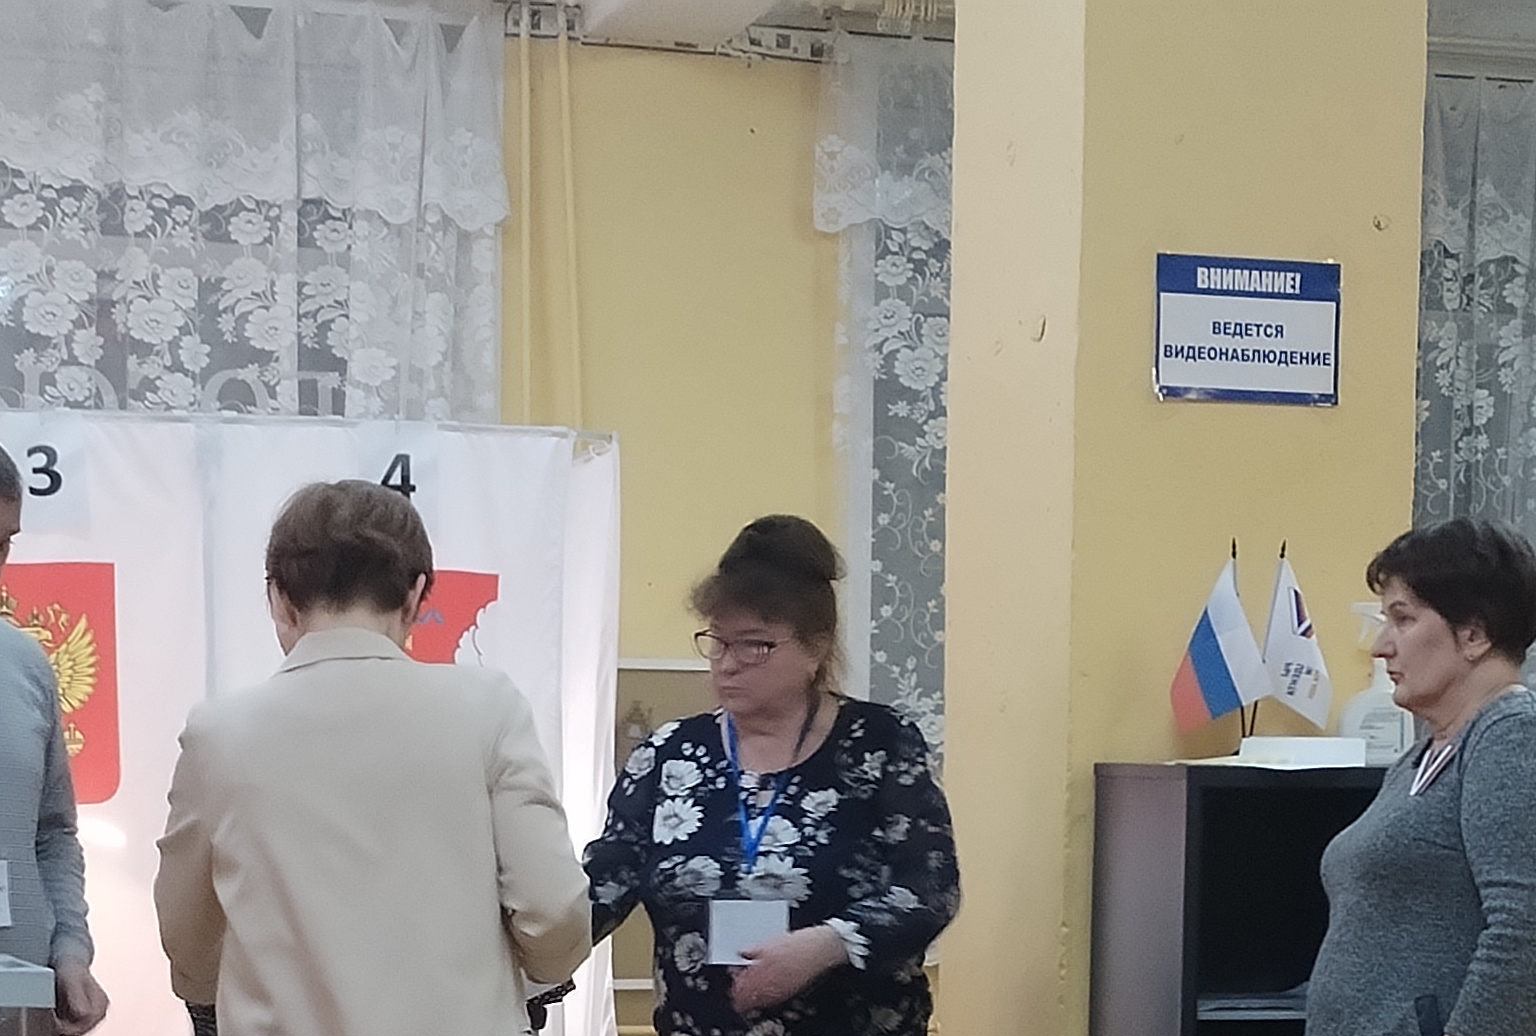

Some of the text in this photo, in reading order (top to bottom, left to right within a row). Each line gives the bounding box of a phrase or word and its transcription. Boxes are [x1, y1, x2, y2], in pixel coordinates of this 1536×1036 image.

[1197, 267, 1302, 294] ВНИМАНИЕ!
[1212, 320, 1285, 340] ВЕДЕТСЯ
[1163, 344, 1332, 367] ВИДЕОНАБЛЮДЕНИЕ
[26, 444, 63, 497] 3
[380, 453, 417, 499] 4
